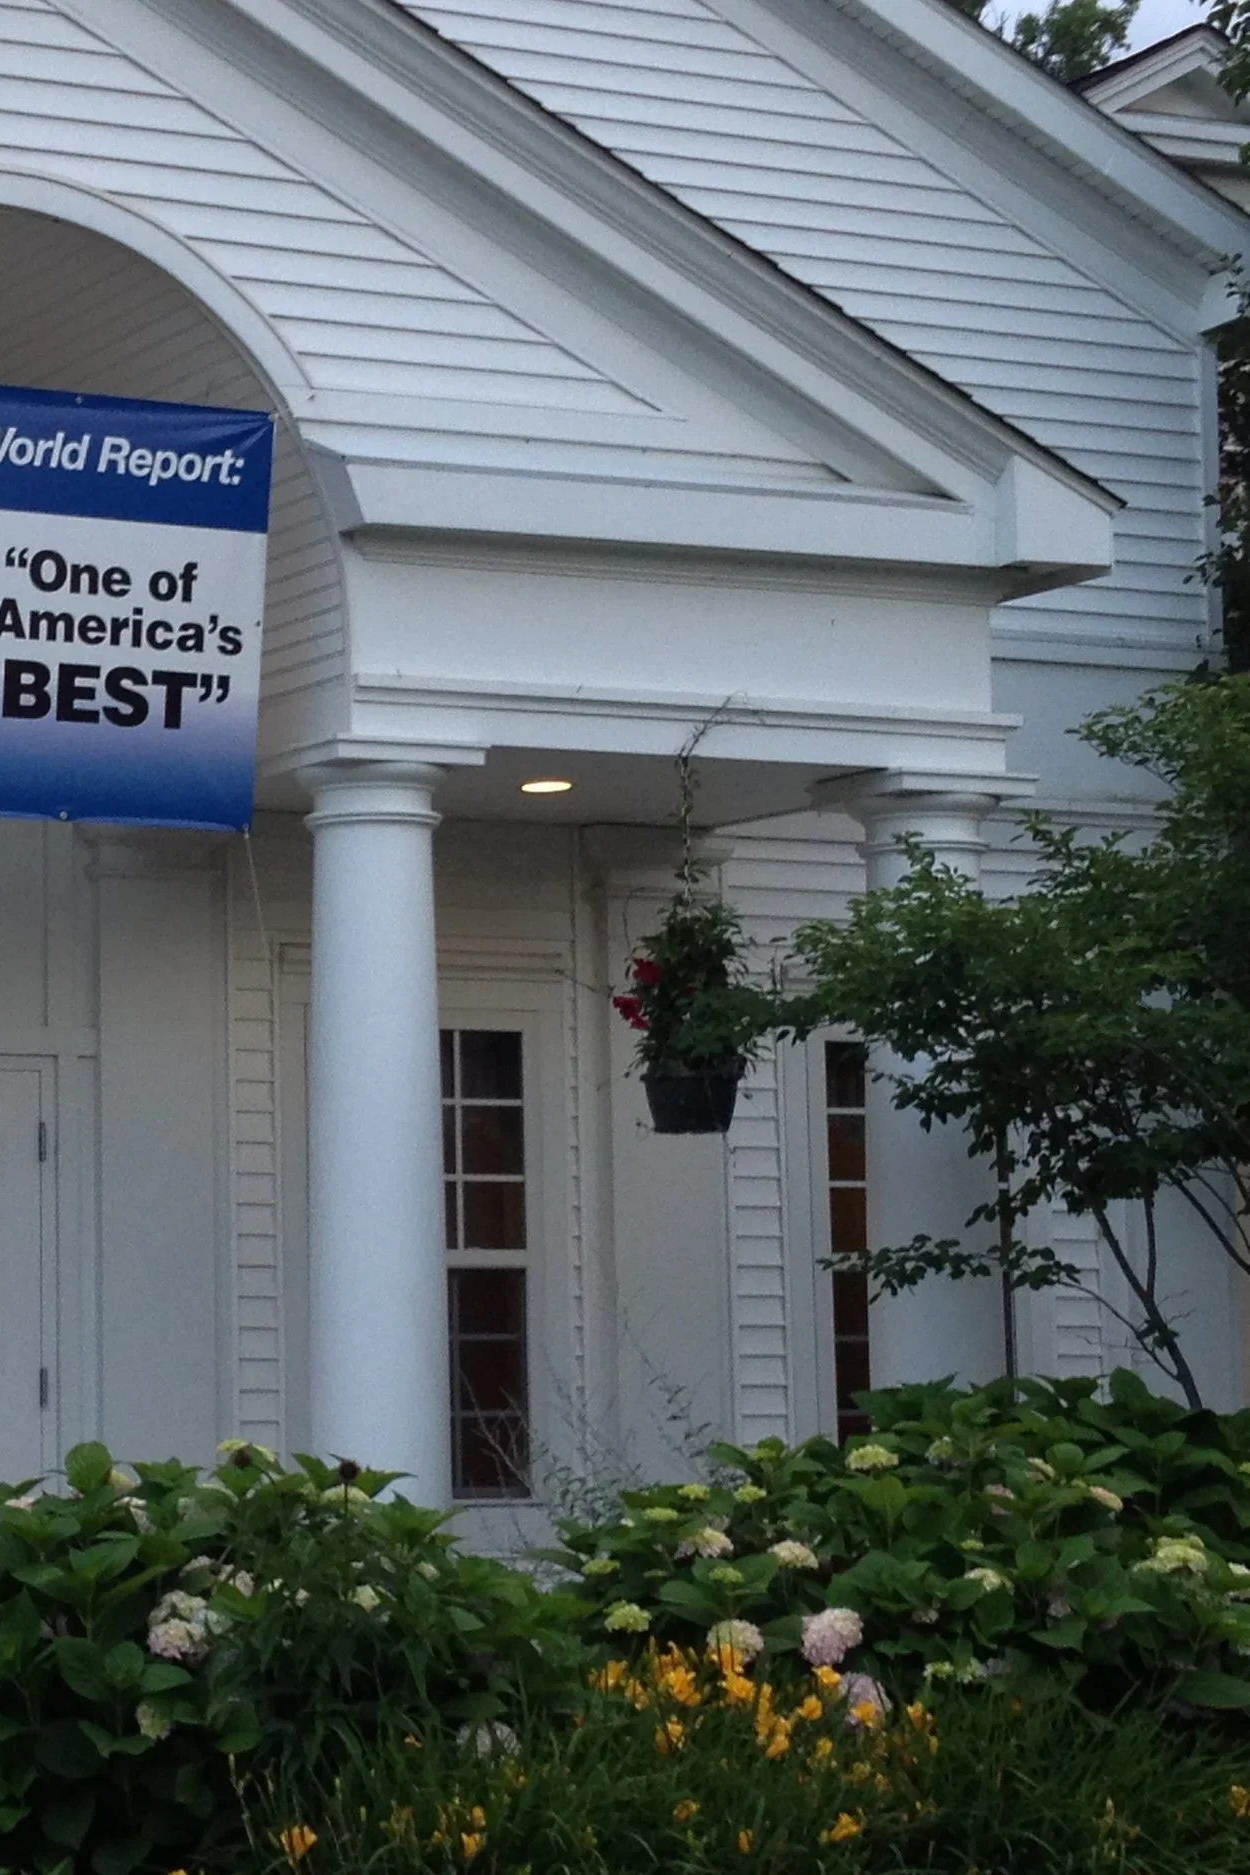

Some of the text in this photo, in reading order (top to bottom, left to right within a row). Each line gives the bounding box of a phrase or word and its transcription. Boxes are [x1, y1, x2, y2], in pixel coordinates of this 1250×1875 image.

[97, 437, 245, 486] Report:
[4, 547, 198, 603] “One of
[1, 660, 231, 729] BEST”
